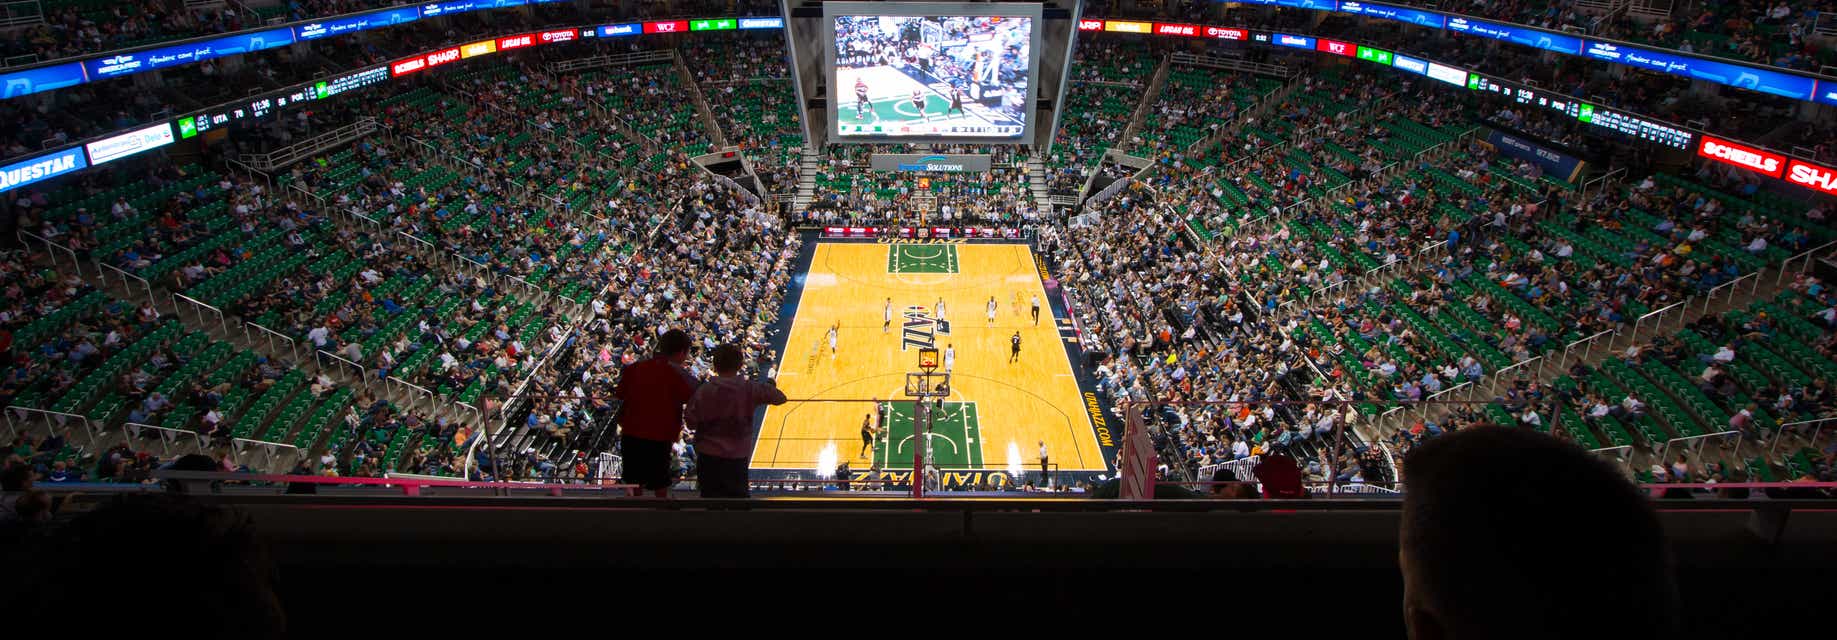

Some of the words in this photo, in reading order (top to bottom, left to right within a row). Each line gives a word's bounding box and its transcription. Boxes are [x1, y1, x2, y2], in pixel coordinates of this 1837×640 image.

[551, 31, 574, 40] TOYOTA
[1160, 25, 1182, 34] LUCAS
[1182, 26, 1194, 35] OIL
[1218, 29, 1242, 38] TOYOTA
[428, 49, 459, 66] SHARP
[213, 114, 228, 125] UTA
[252, 100, 270, 112] 11:36
[291, 92, 304, 103] POR
[1552, 101, 1566, 111] POR
[1703, 141, 1779, 172] SCHEELS
[0, 154, 76, 190] QUESTAR
